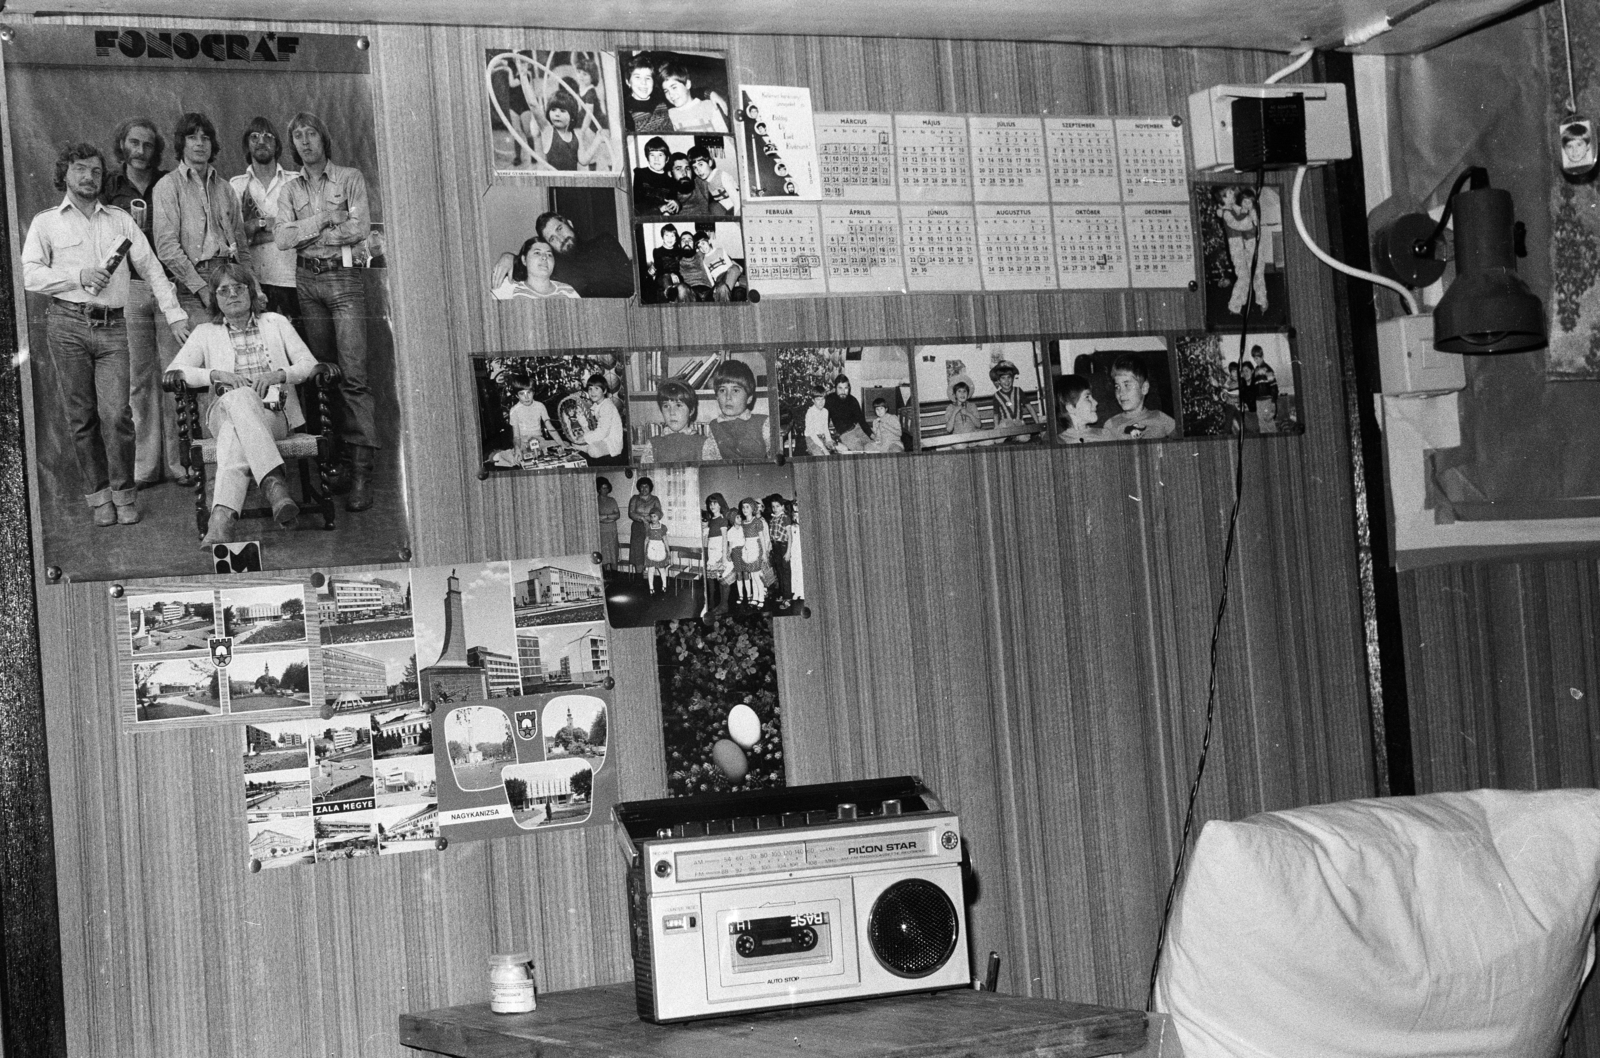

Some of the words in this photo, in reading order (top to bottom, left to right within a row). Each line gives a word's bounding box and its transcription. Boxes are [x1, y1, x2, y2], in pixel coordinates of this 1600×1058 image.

[316, 804, 340, 814] ZALA
[343, 801, 373, 811] MEGYE
[451, 809, 500, 820] NAGYKANIZSA
[886, 842, 916, 851] STAR
